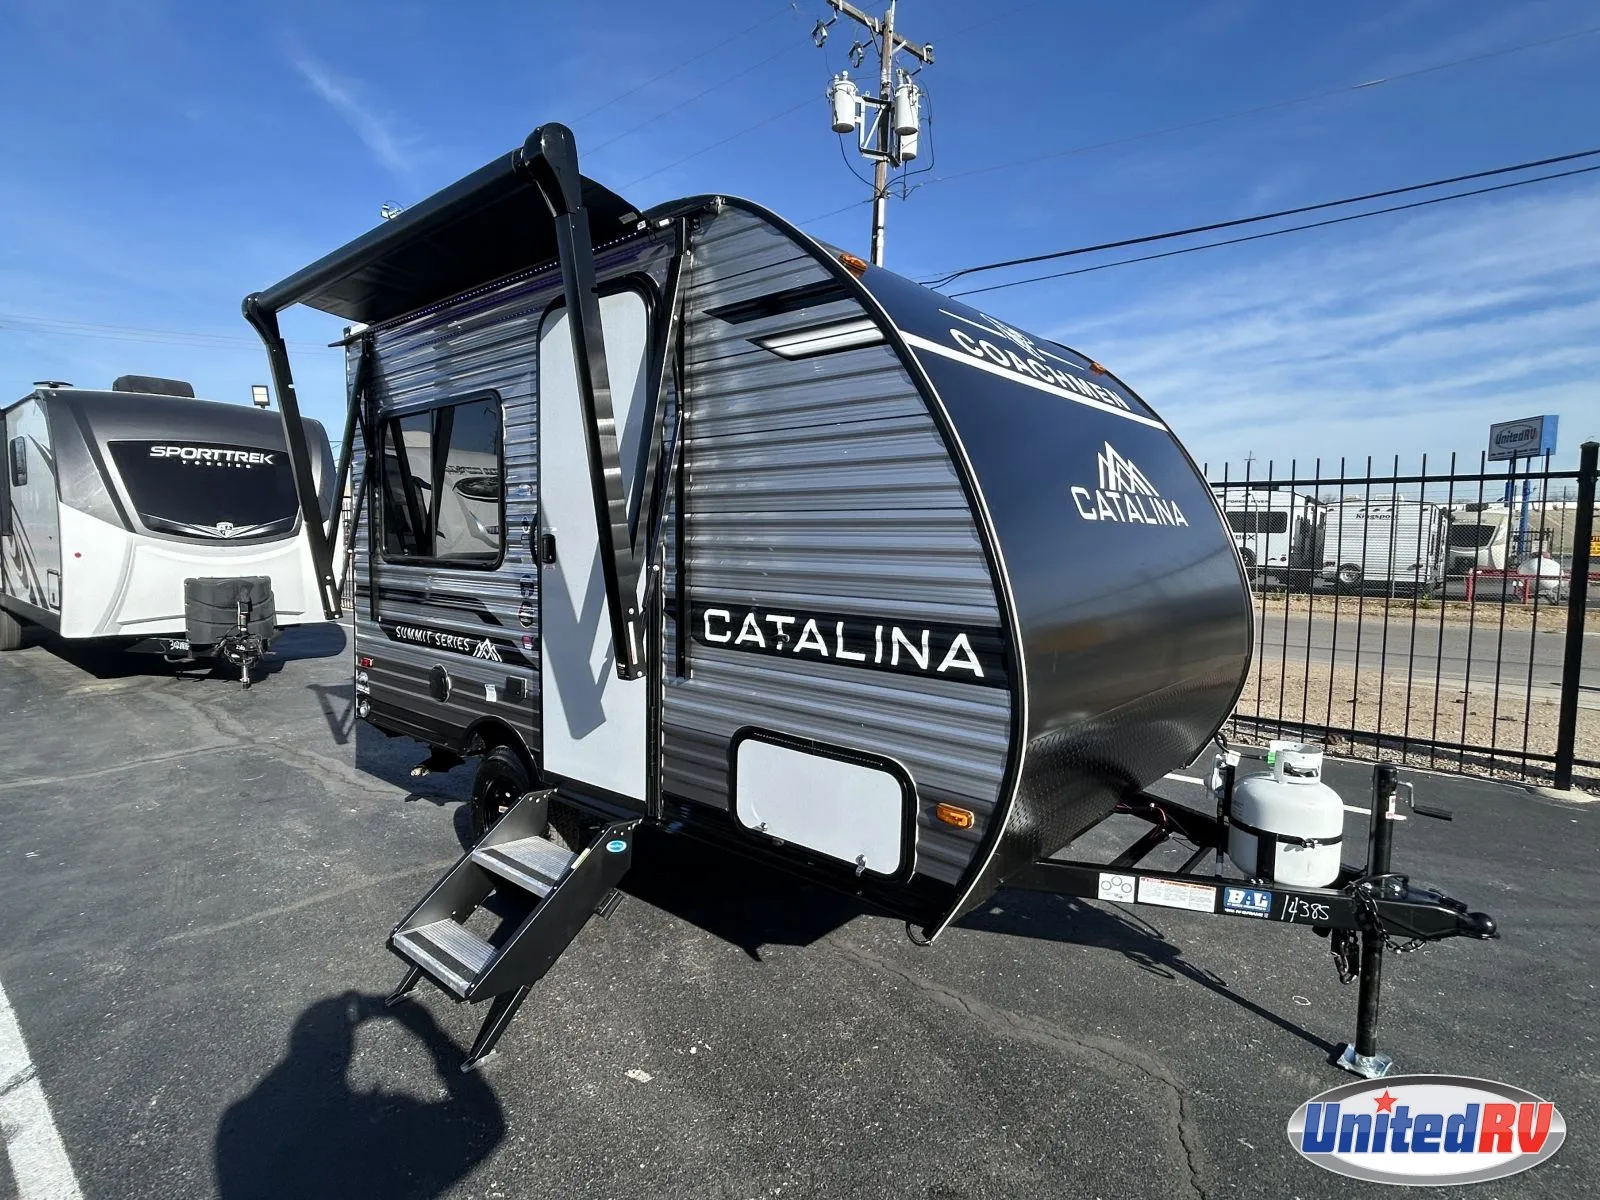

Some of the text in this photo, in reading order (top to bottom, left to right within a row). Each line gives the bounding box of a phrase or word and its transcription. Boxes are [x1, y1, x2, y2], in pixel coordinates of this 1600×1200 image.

[950, 328, 1131, 411] COACHMEN
[149, 445, 275, 465] SPORTTREK
[1070, 486, 1189, 527] CATALINA
[396, 625, 470, 652] SUMMIT SERIES
[703, 608, 985, 678] CATALINA
[1227, 889, 1268, 907] BAL
[1281, 894, 1330, 922] 14385
